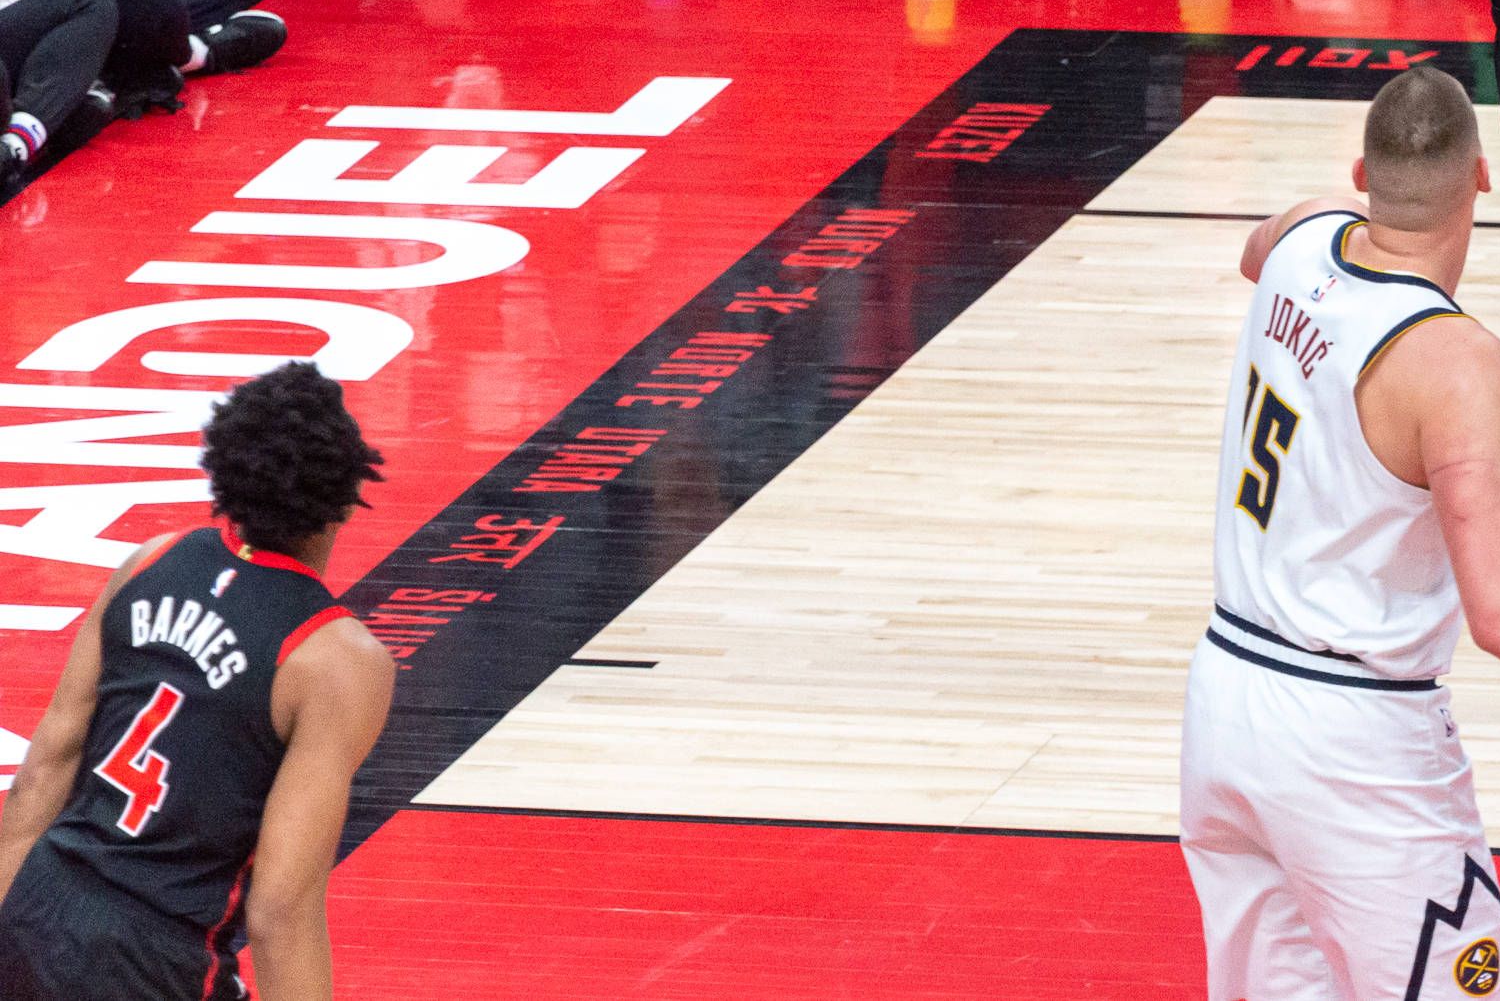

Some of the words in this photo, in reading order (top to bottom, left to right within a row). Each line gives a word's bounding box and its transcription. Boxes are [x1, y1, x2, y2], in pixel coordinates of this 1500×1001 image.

[914, 102, 1052, 163] KUZEY
[781, 208, 919, 270] NORD
[615, 330, 774, 411] NORTE
[1264, 293, 1334, 381] JOKIĆ
[512, 426, 669, 493] UTARA
[1234, 361, 1302, 534] 15
[131, 596, 248, 690] BARNES
[93, 681, 186, 837] 4
